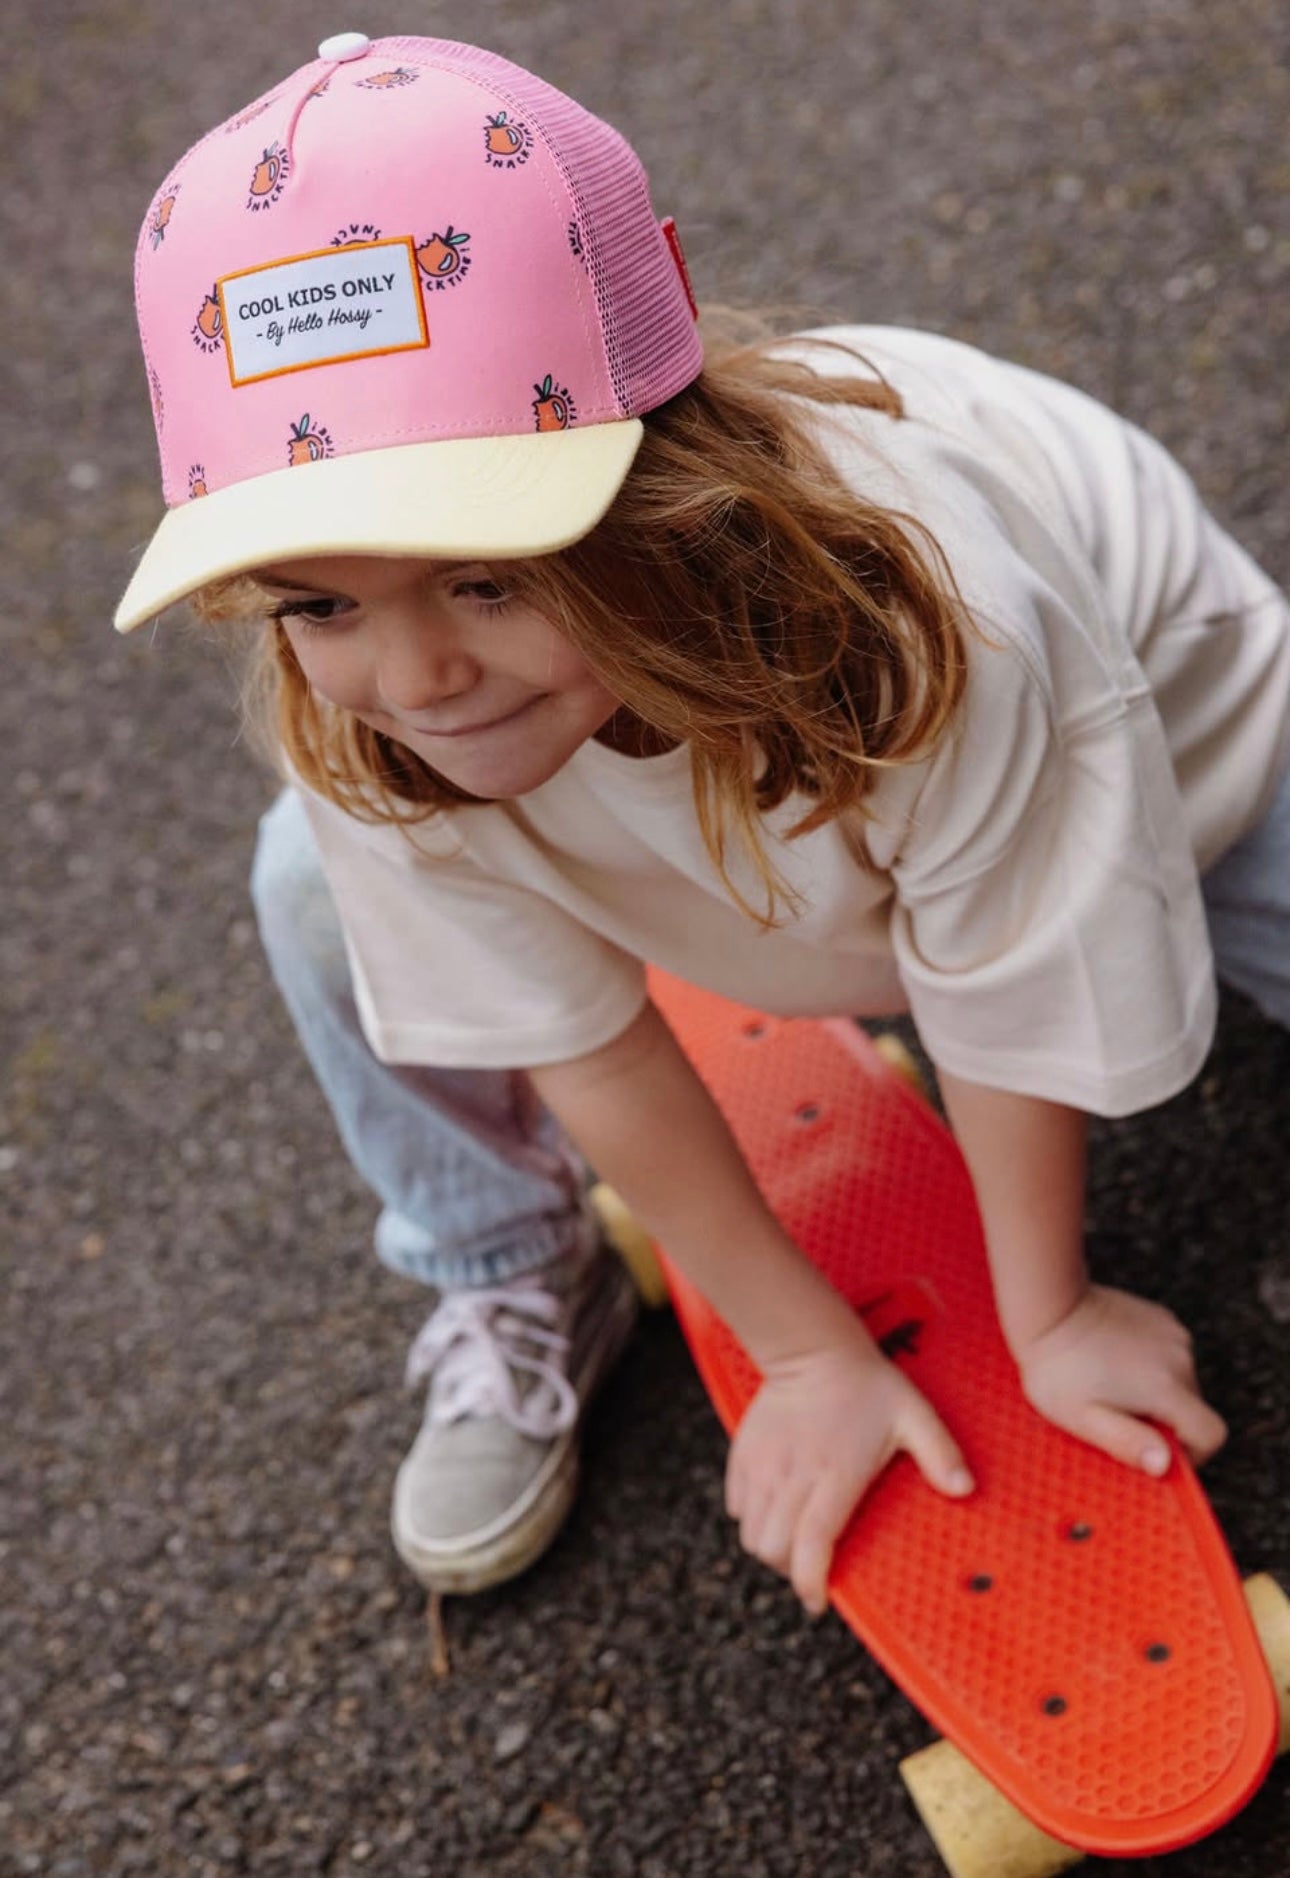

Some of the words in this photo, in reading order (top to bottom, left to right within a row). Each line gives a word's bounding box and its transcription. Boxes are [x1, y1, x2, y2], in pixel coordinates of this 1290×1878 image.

[485, 150, 530, 169] SNACK
[246, 184, 284, 212] SNACK
[239, 295, 285, 320] COOL
[287, 284, 337, 308] KIDS
[342, 273, 395, 297] ONLY
[266, 321, 285, 346] By
[288, 312, 323, 335] Hello
[327, 308, 372, 330] Hossy
